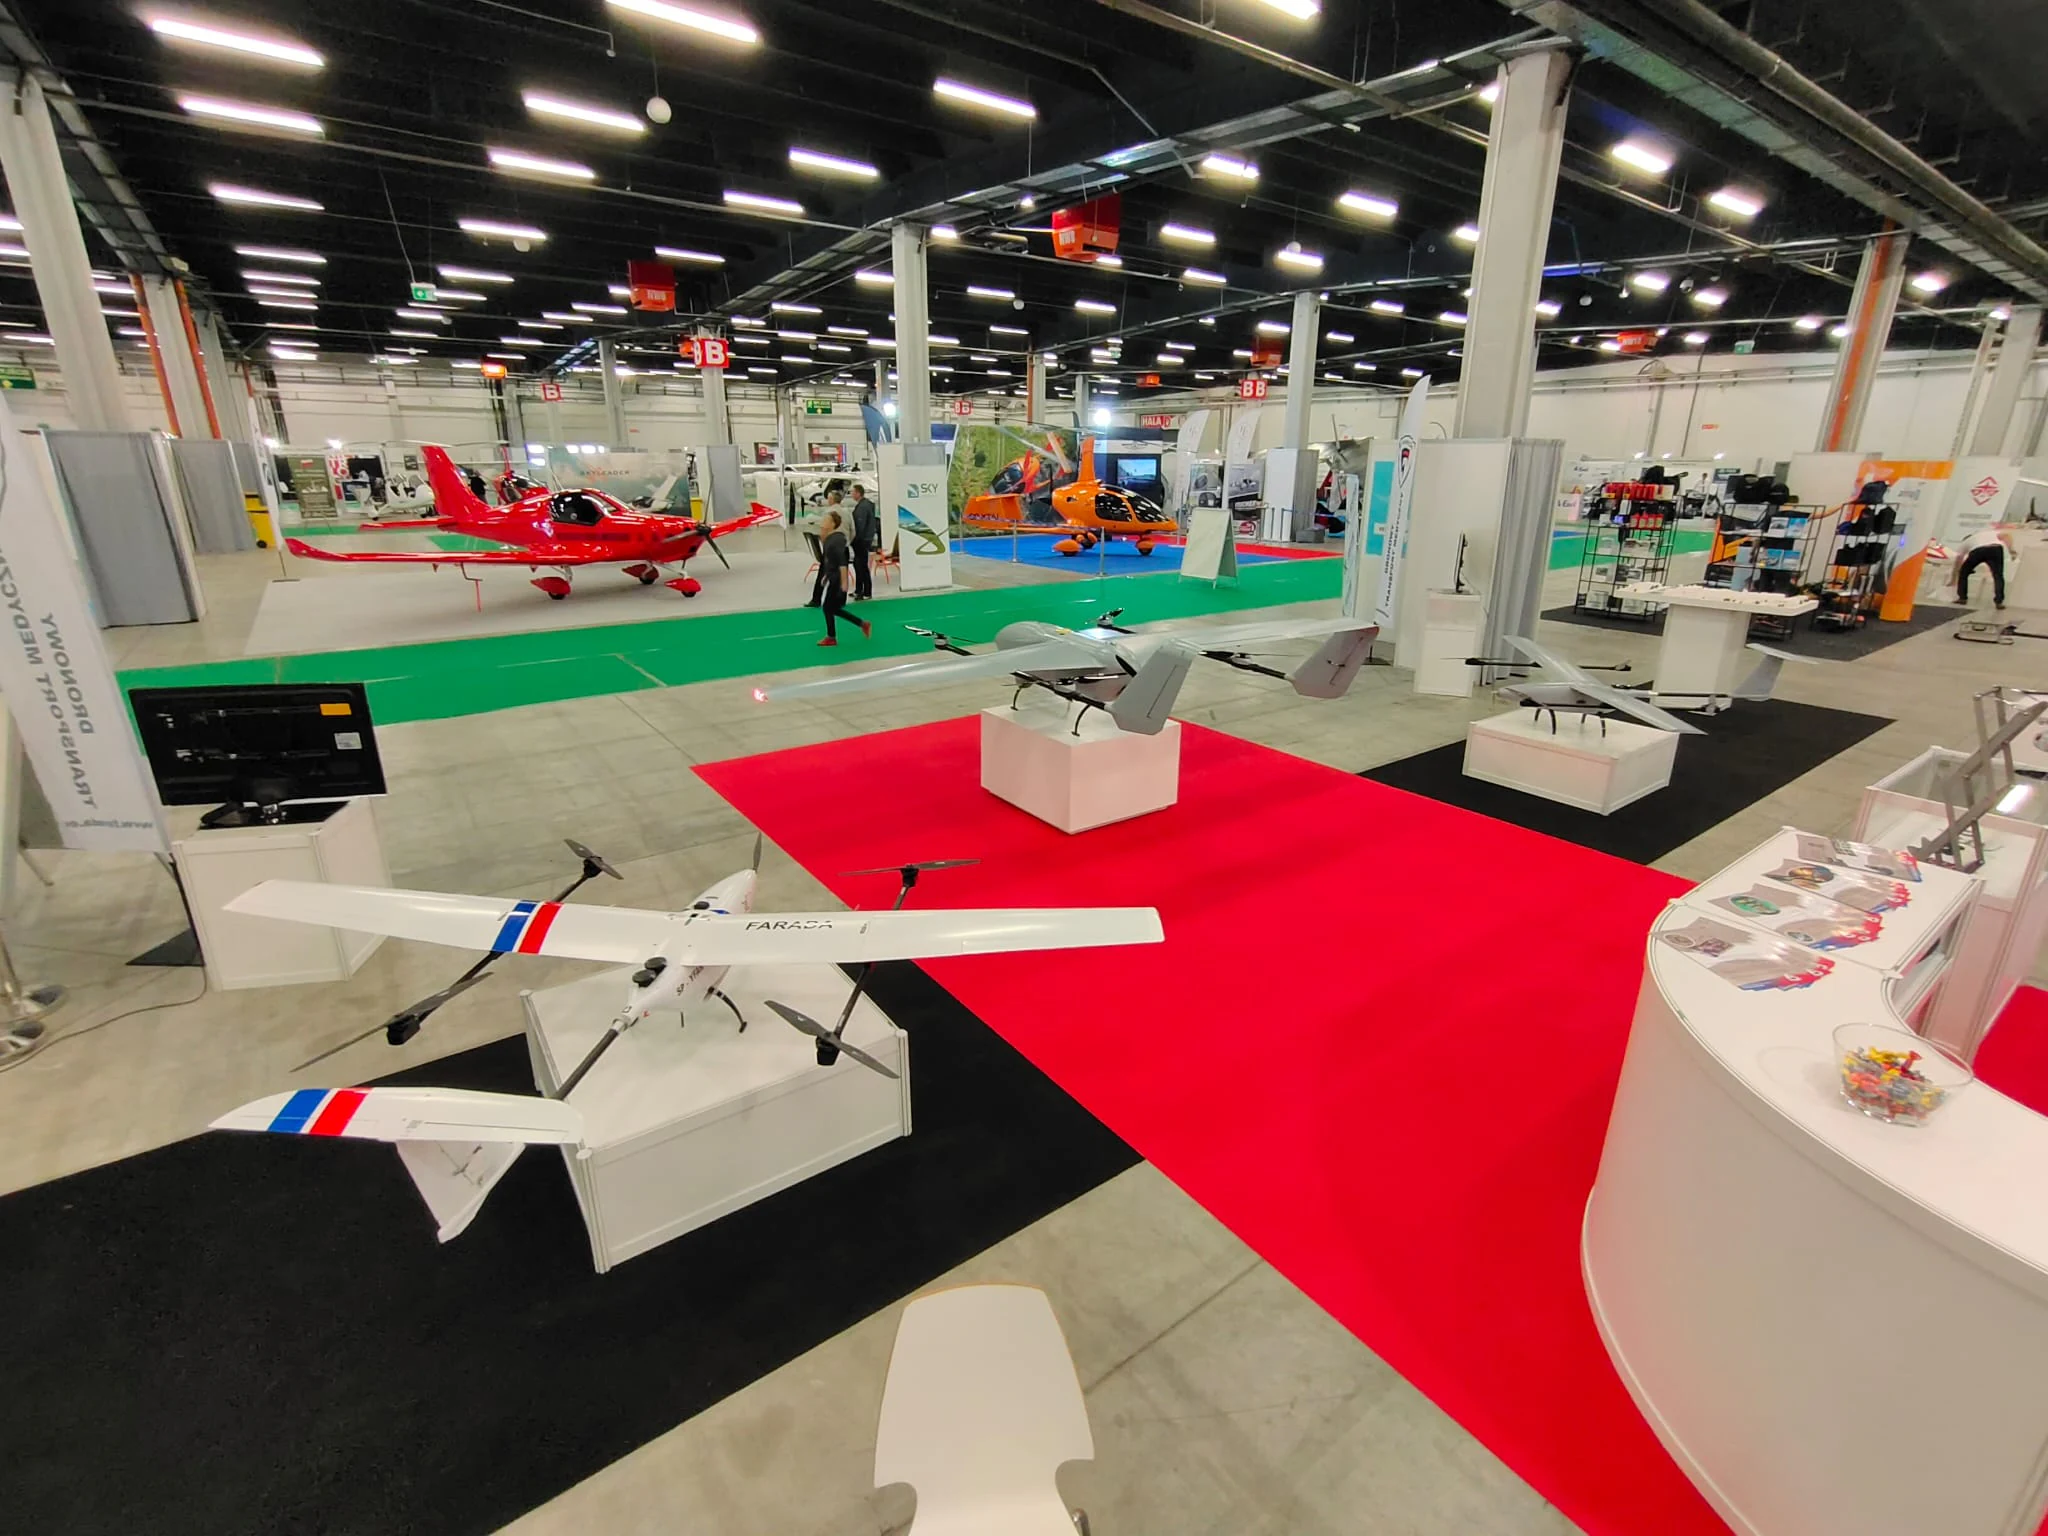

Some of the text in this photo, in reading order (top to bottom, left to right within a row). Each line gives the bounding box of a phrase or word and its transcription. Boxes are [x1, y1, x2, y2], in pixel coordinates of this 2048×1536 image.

[704, 341, 725, 365] B
[545, 385, 558, 400] B
[1243, 381, 1253, 397] B
[1256, 380, 1266, 397] B
[1142, 415, 1162, 427] HALA
[921, 484, 938, 494] SKY
[745, 920, 834, 931] FARADA
